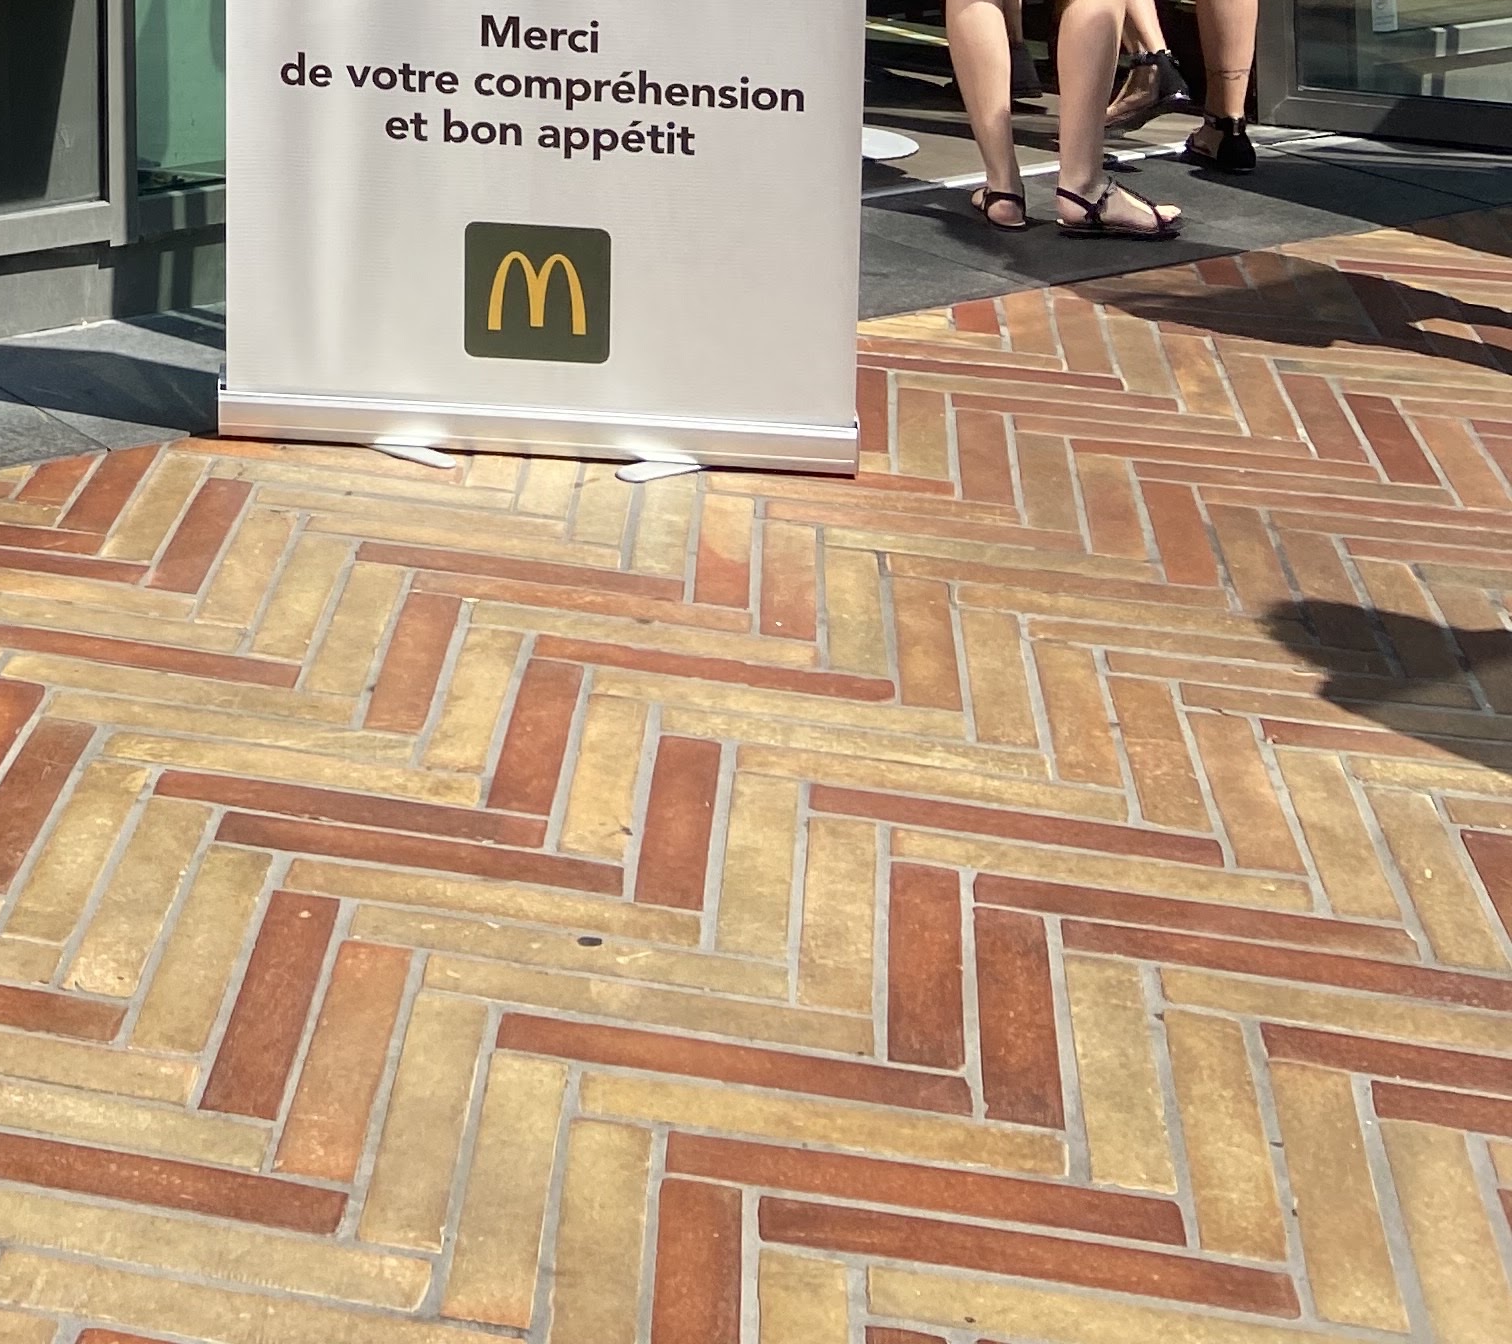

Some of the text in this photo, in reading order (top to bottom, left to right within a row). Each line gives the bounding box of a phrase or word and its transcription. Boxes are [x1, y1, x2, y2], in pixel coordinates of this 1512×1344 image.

[480, 15, 600, 54] Merci
[280, 52, 805, 112] de votre compréhension
[385, 108, 696, 160] et bon appétit
